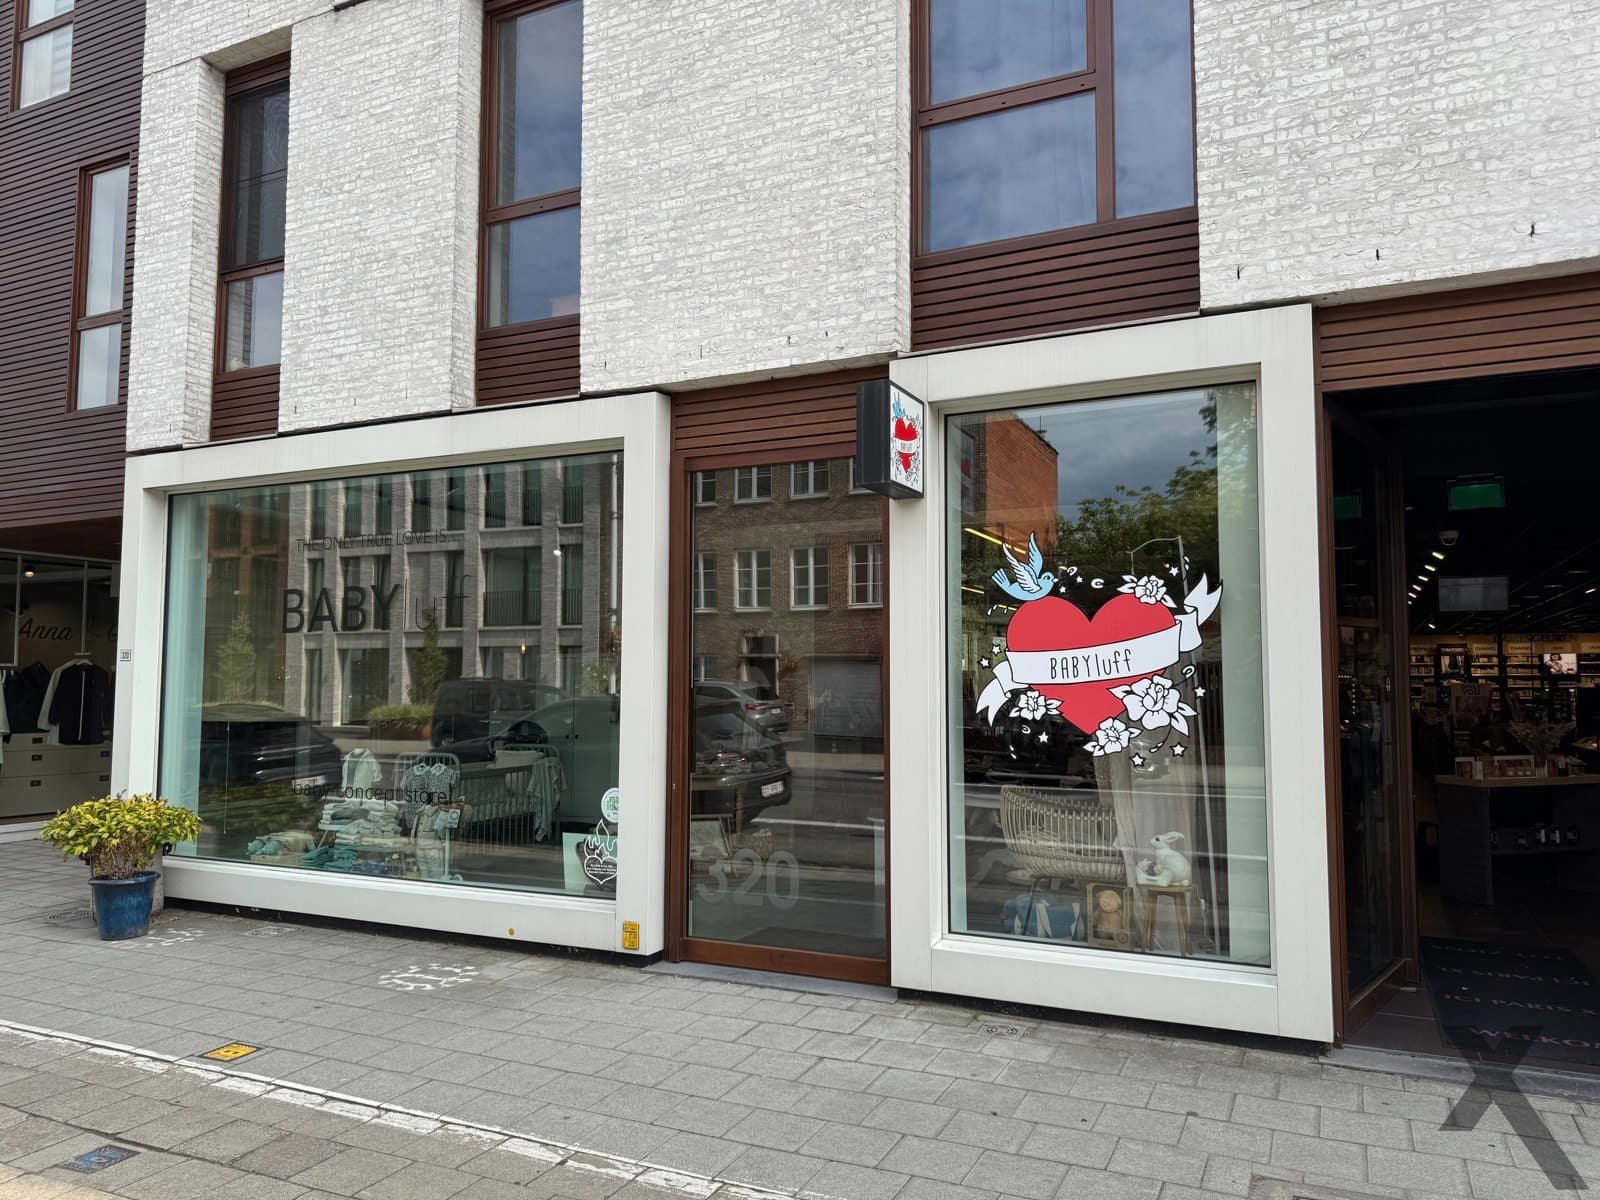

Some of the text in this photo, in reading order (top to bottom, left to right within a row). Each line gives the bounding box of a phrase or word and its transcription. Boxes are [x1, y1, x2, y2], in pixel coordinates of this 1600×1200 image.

[296, 538, 321, 552] THE
[323, 536, 354, 551] ONLY
[359, 533, 392, 547] TRUE
[397, 529, 431, 545] LOVE
[18, 617, 72, 641] Anna
[1050, 648, 1131, 680] BABYluff
[695, 846, 799, 910] 320
